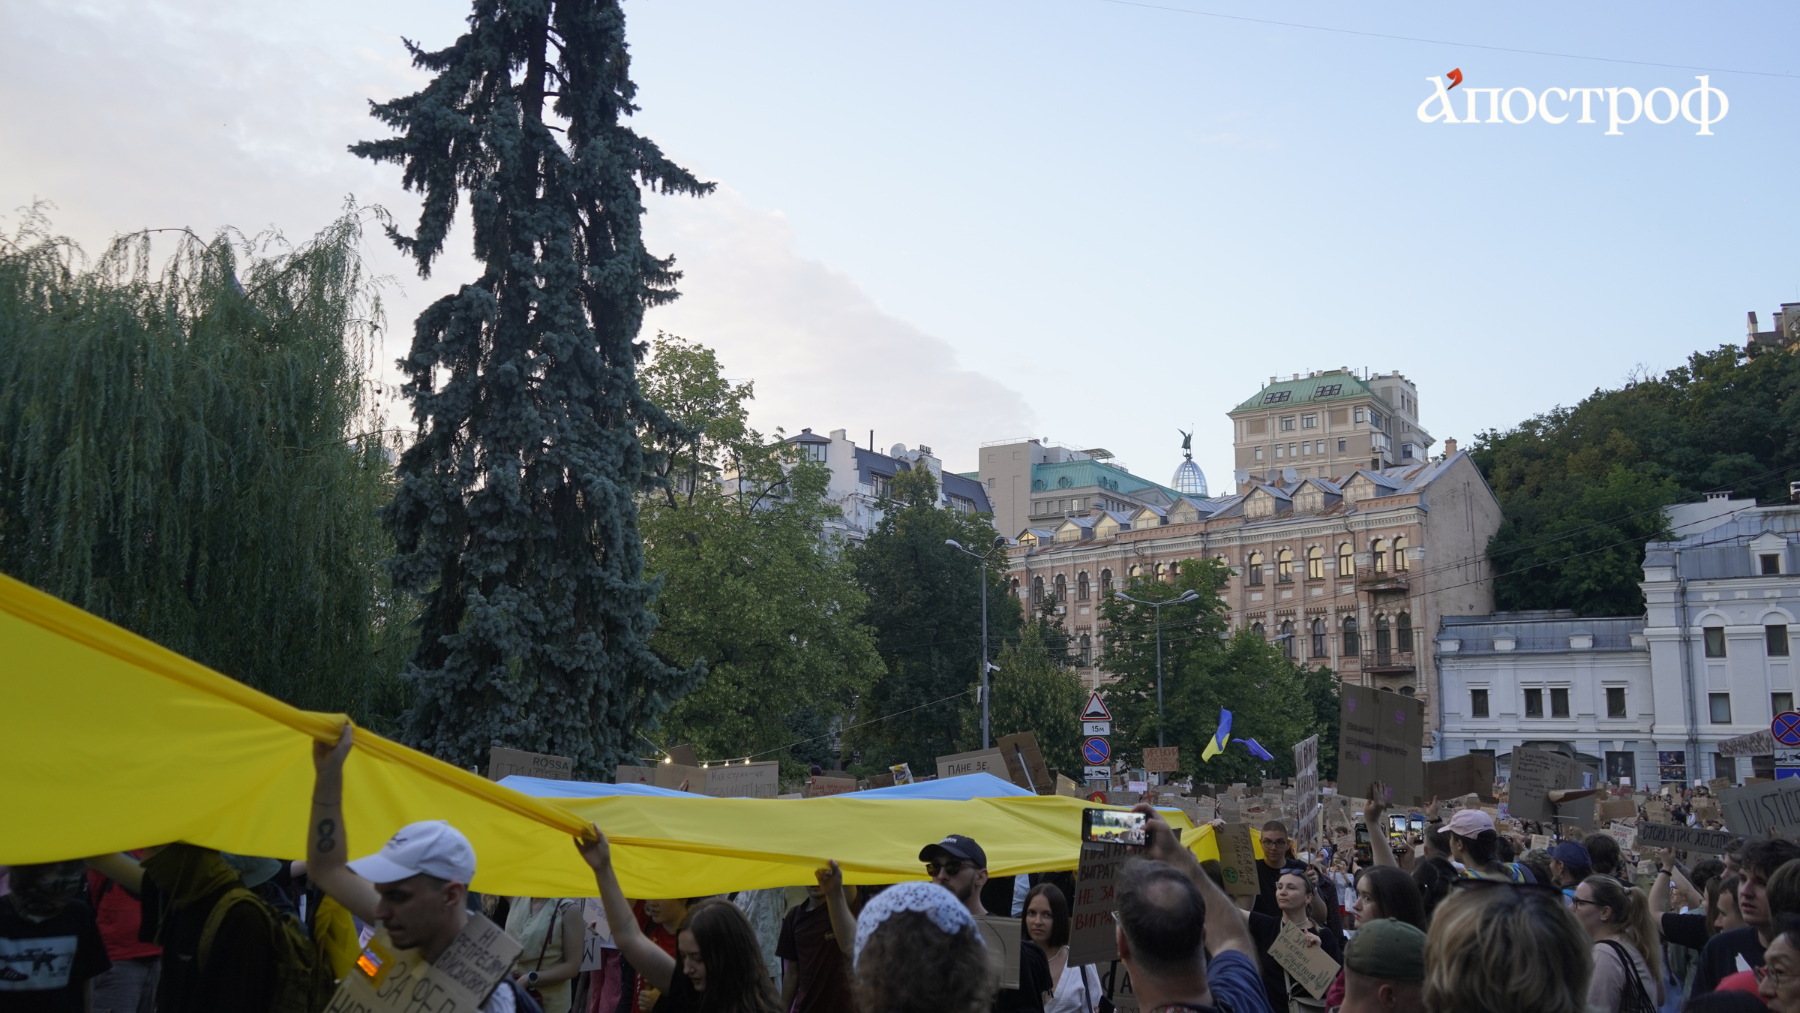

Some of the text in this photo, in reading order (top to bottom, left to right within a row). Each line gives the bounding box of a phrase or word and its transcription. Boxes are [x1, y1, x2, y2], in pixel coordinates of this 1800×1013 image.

[948, 763, 971, 775] ПАНЕ
[1080, 861, 1120, 882] ВИГРАТ
[1078, 885, 1114, 906] НЕ ЗА
[1075, 909, 1118, 931] ВИГРА
[478, 927, 501, 948] НІ
[1292, 932, 1308, 949] ЗА
[1277, 935, 1312, 964] ЕФЕКТИВНІ
[1285, 952, 1316, 981] РІШЕННЯ
[377, 961, 412, 1007] ЗА
